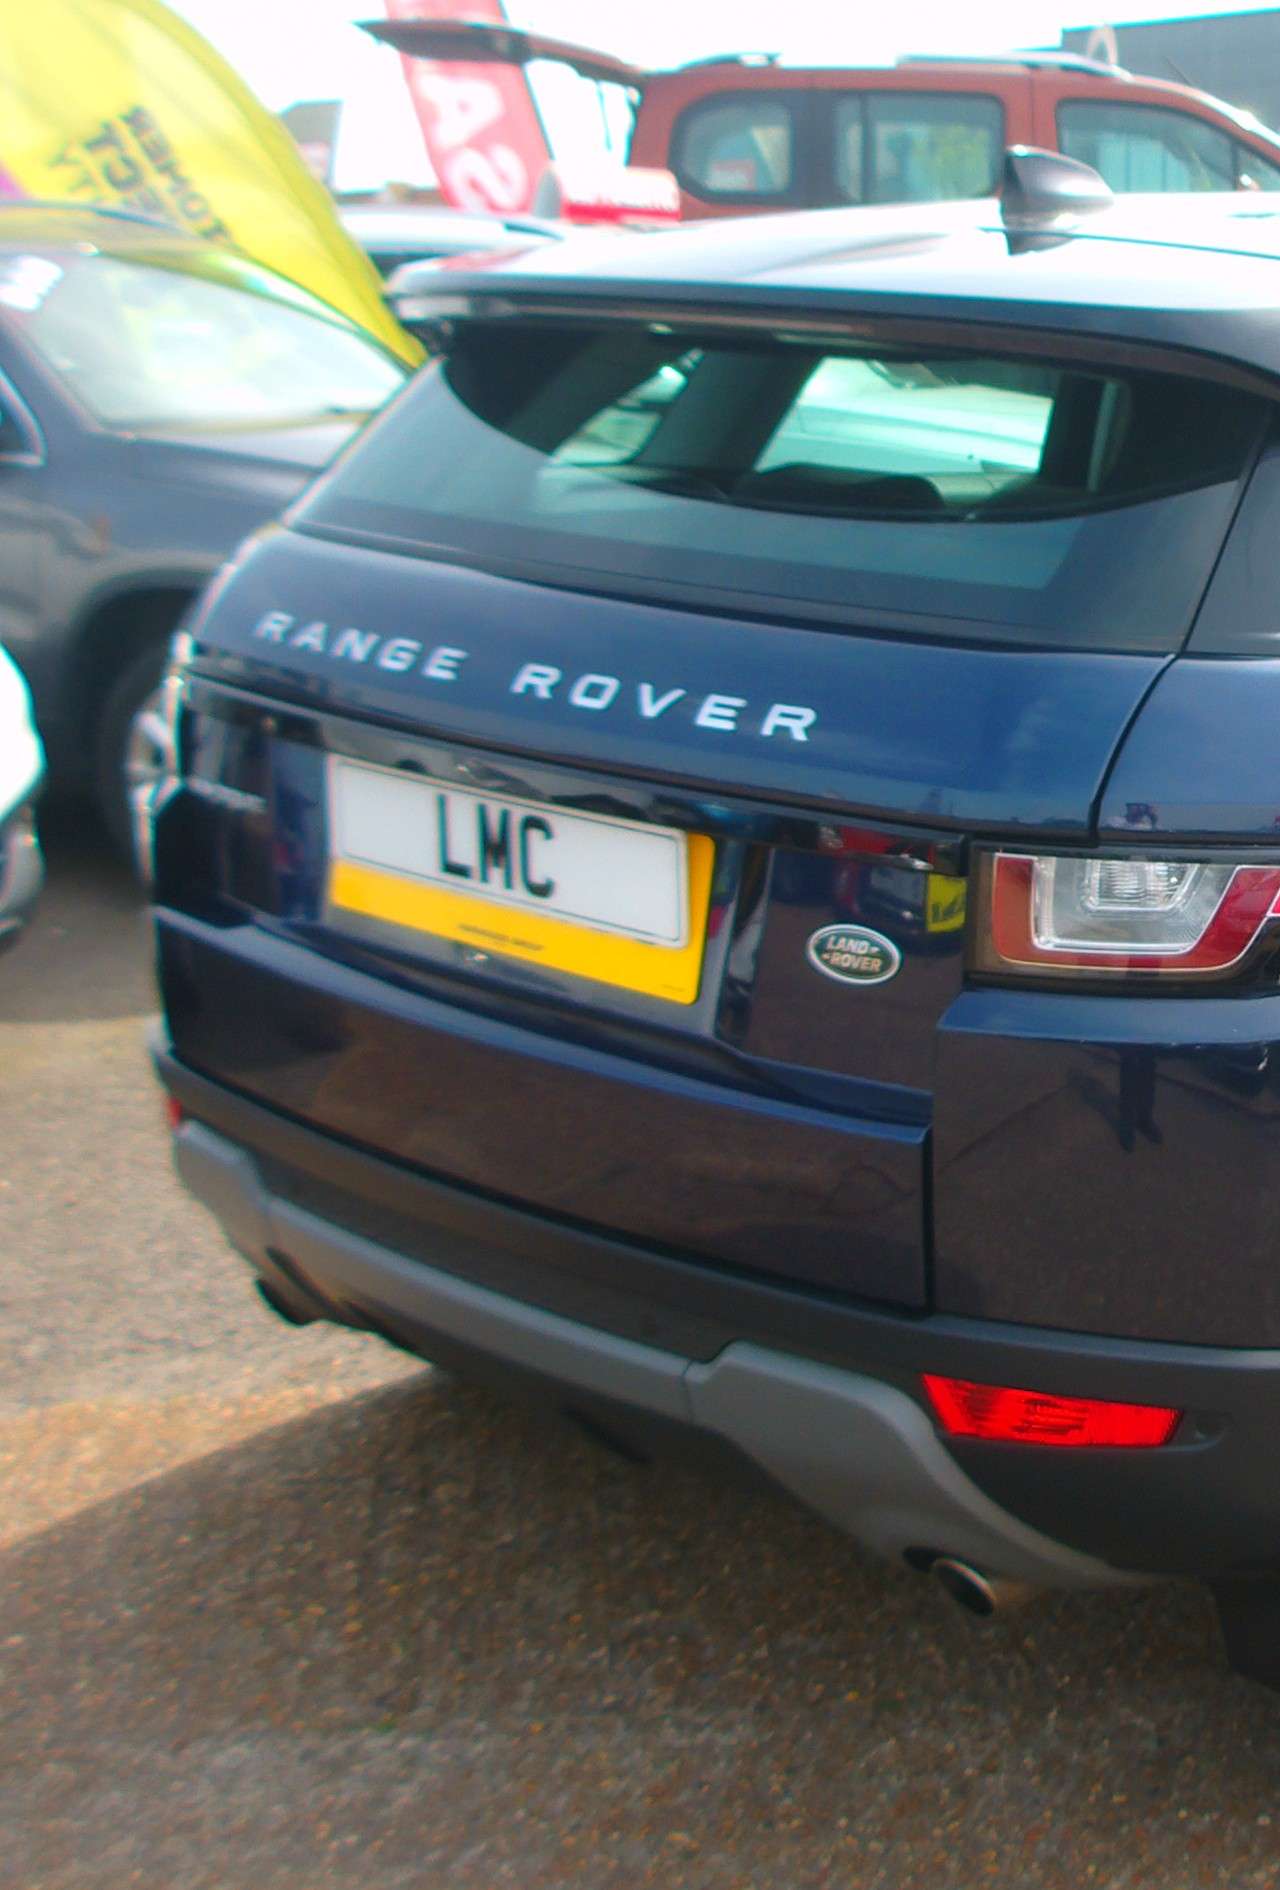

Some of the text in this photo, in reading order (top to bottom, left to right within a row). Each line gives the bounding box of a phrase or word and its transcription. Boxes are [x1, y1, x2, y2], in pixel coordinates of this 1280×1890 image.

[252, 610, 819, 742] RANGE ROVER
[435, 793, 556, 900] LMC
